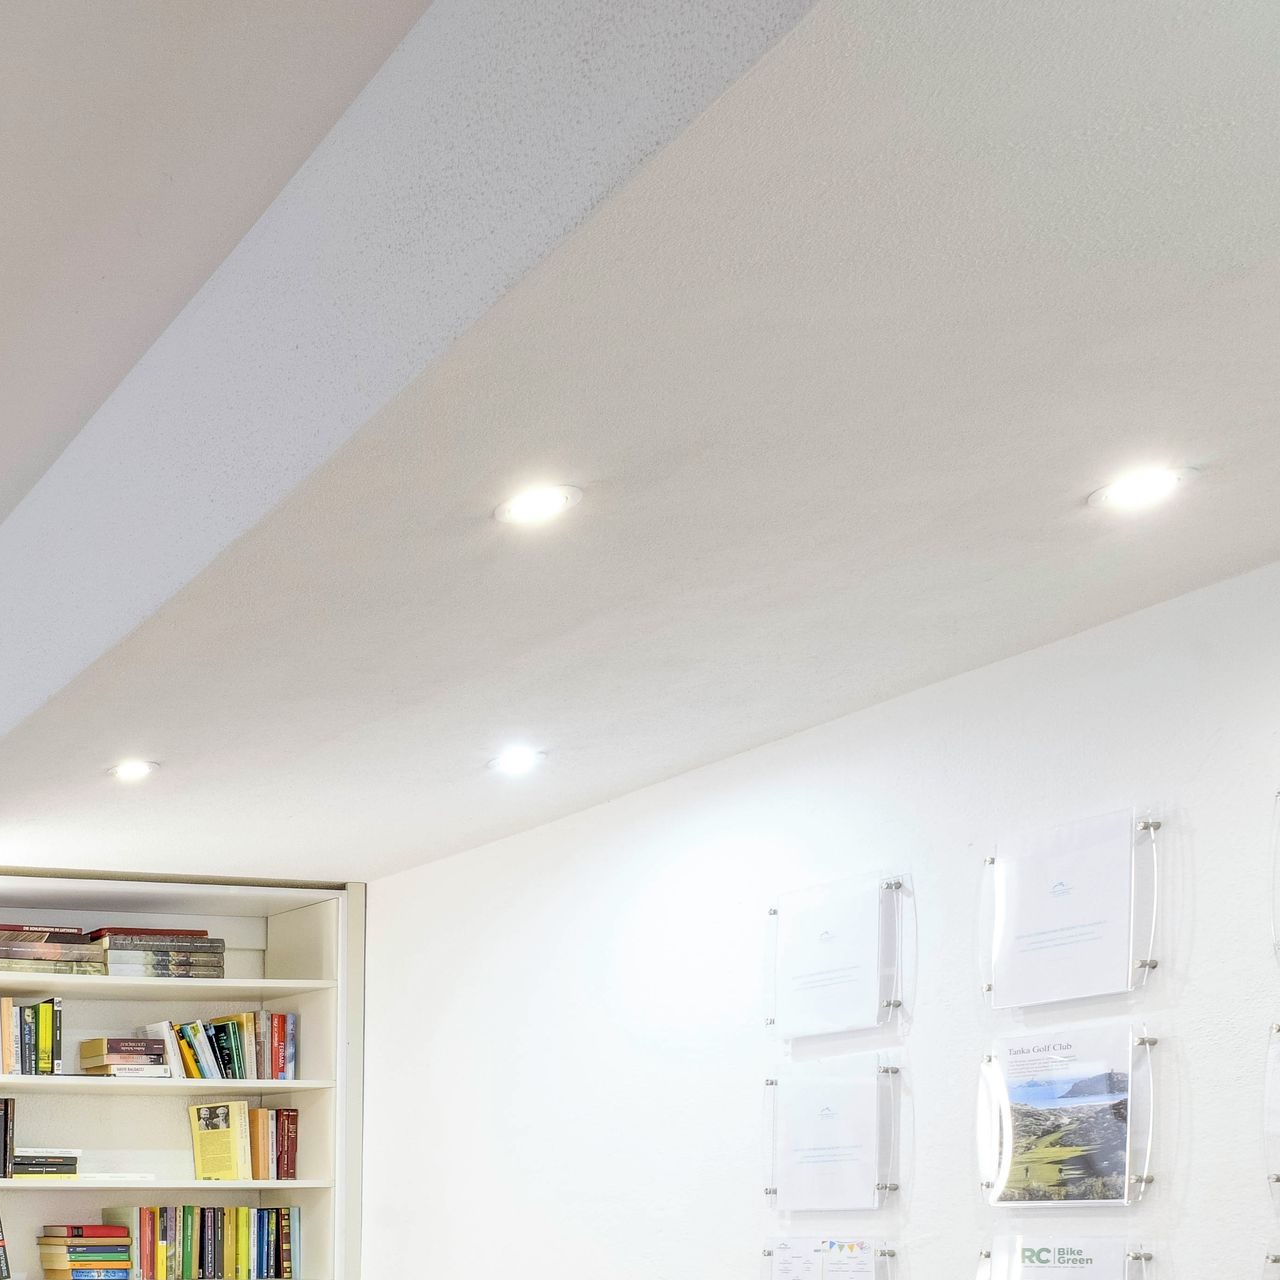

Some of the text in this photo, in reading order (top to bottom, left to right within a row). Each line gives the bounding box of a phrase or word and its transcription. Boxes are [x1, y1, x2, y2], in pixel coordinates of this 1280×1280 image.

[1032, 1045, 1050, 1053] Golf
[1052, 1043, 1072, 1051] Club
[1057, 1247, 1083, 1256] Bike
[1057, 1256, 1093, 1265] Green
